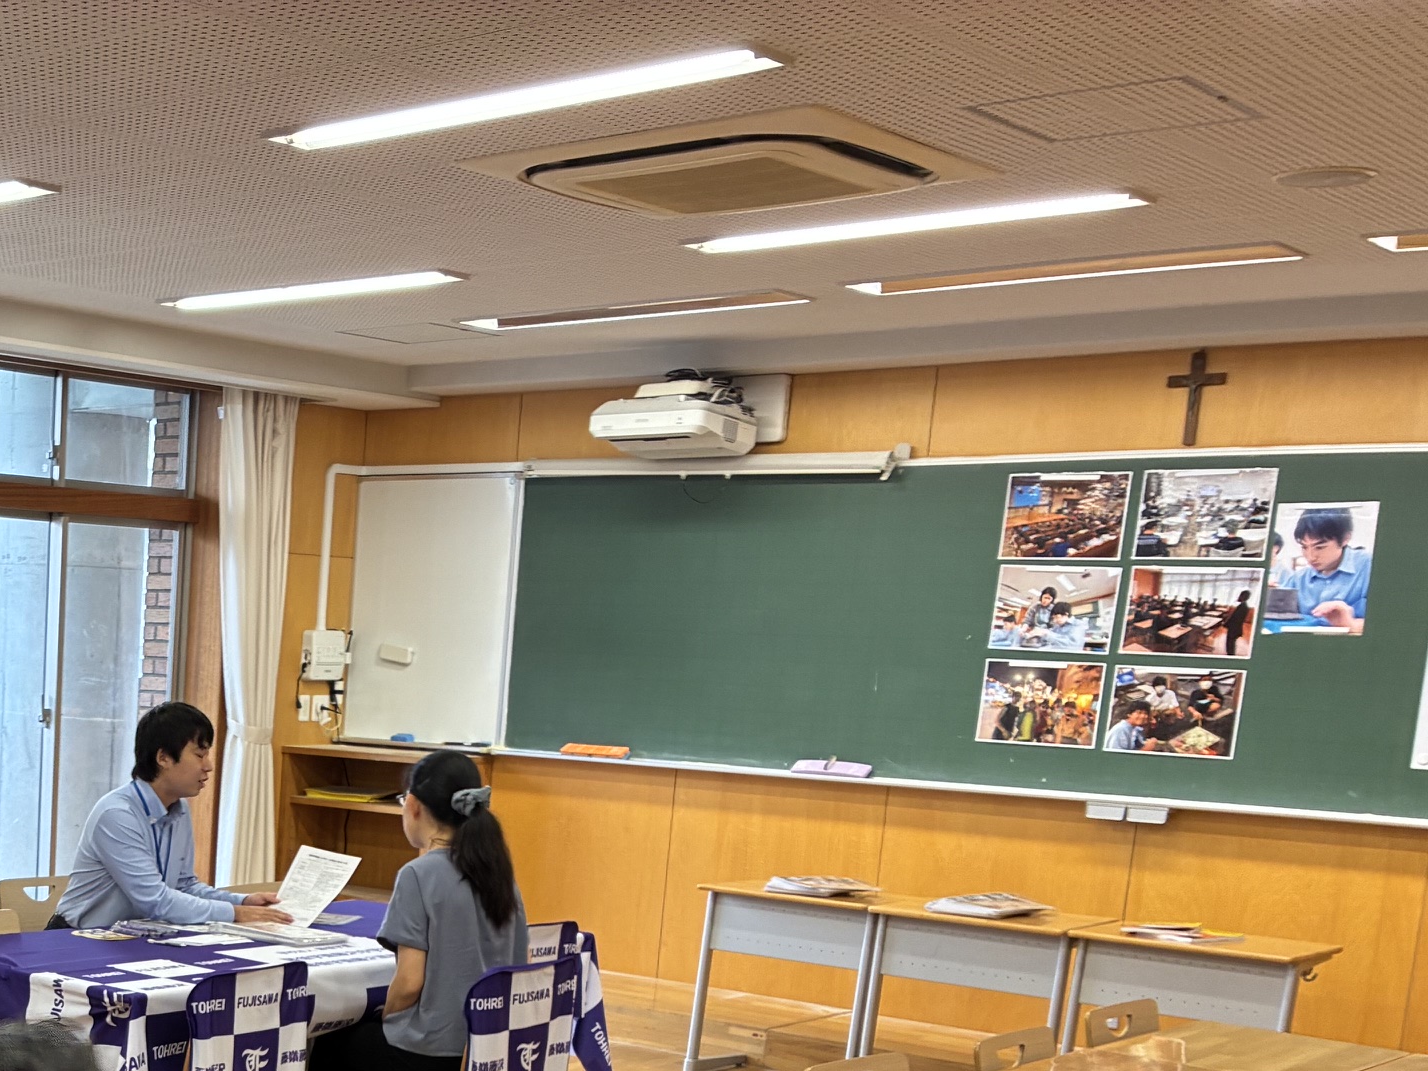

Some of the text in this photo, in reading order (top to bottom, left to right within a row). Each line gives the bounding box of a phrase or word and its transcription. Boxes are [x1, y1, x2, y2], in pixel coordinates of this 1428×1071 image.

[236, 992, 279, 1009] FUJISAWA
[469, 996, 504, 1011] TOHREI
[512, 988, 550, 1005] FUJISAWA
